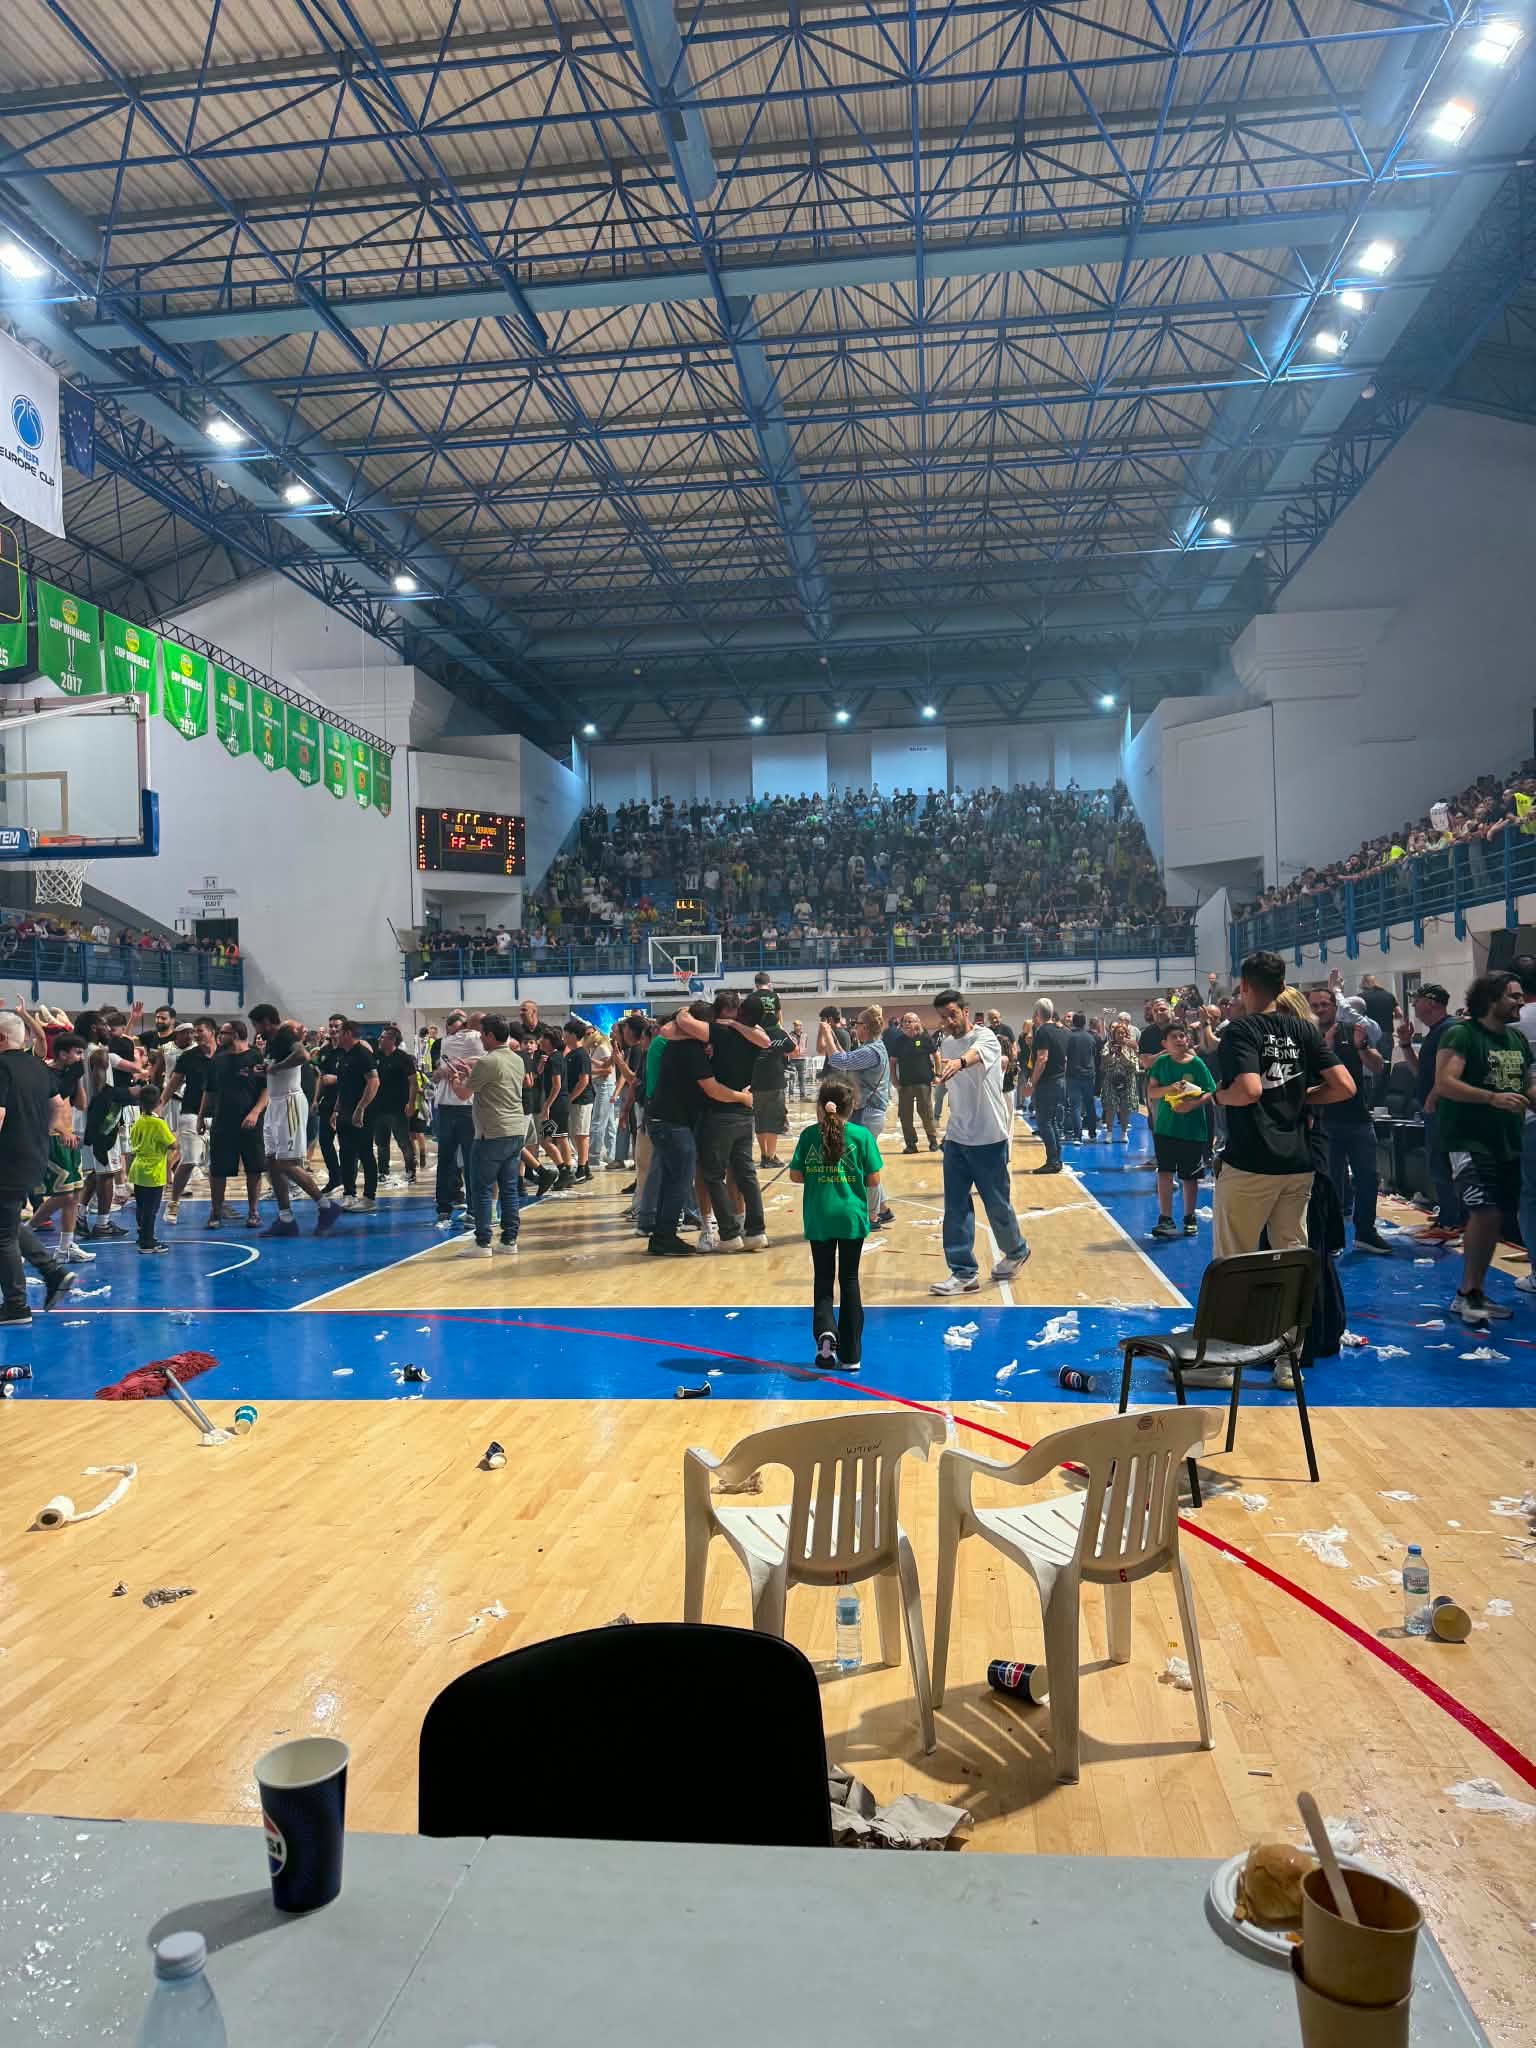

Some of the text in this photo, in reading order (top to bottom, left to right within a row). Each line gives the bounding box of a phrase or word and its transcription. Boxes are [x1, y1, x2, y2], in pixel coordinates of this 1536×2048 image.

[0, 446, 38, 477] EUROPE
[16, 444, 39, 466] FIBA
[49, 616, 91, 644] CUP WINNERS
[60, 671, 83, 694] 2017
[287, 1139, 295, 1152] 2
